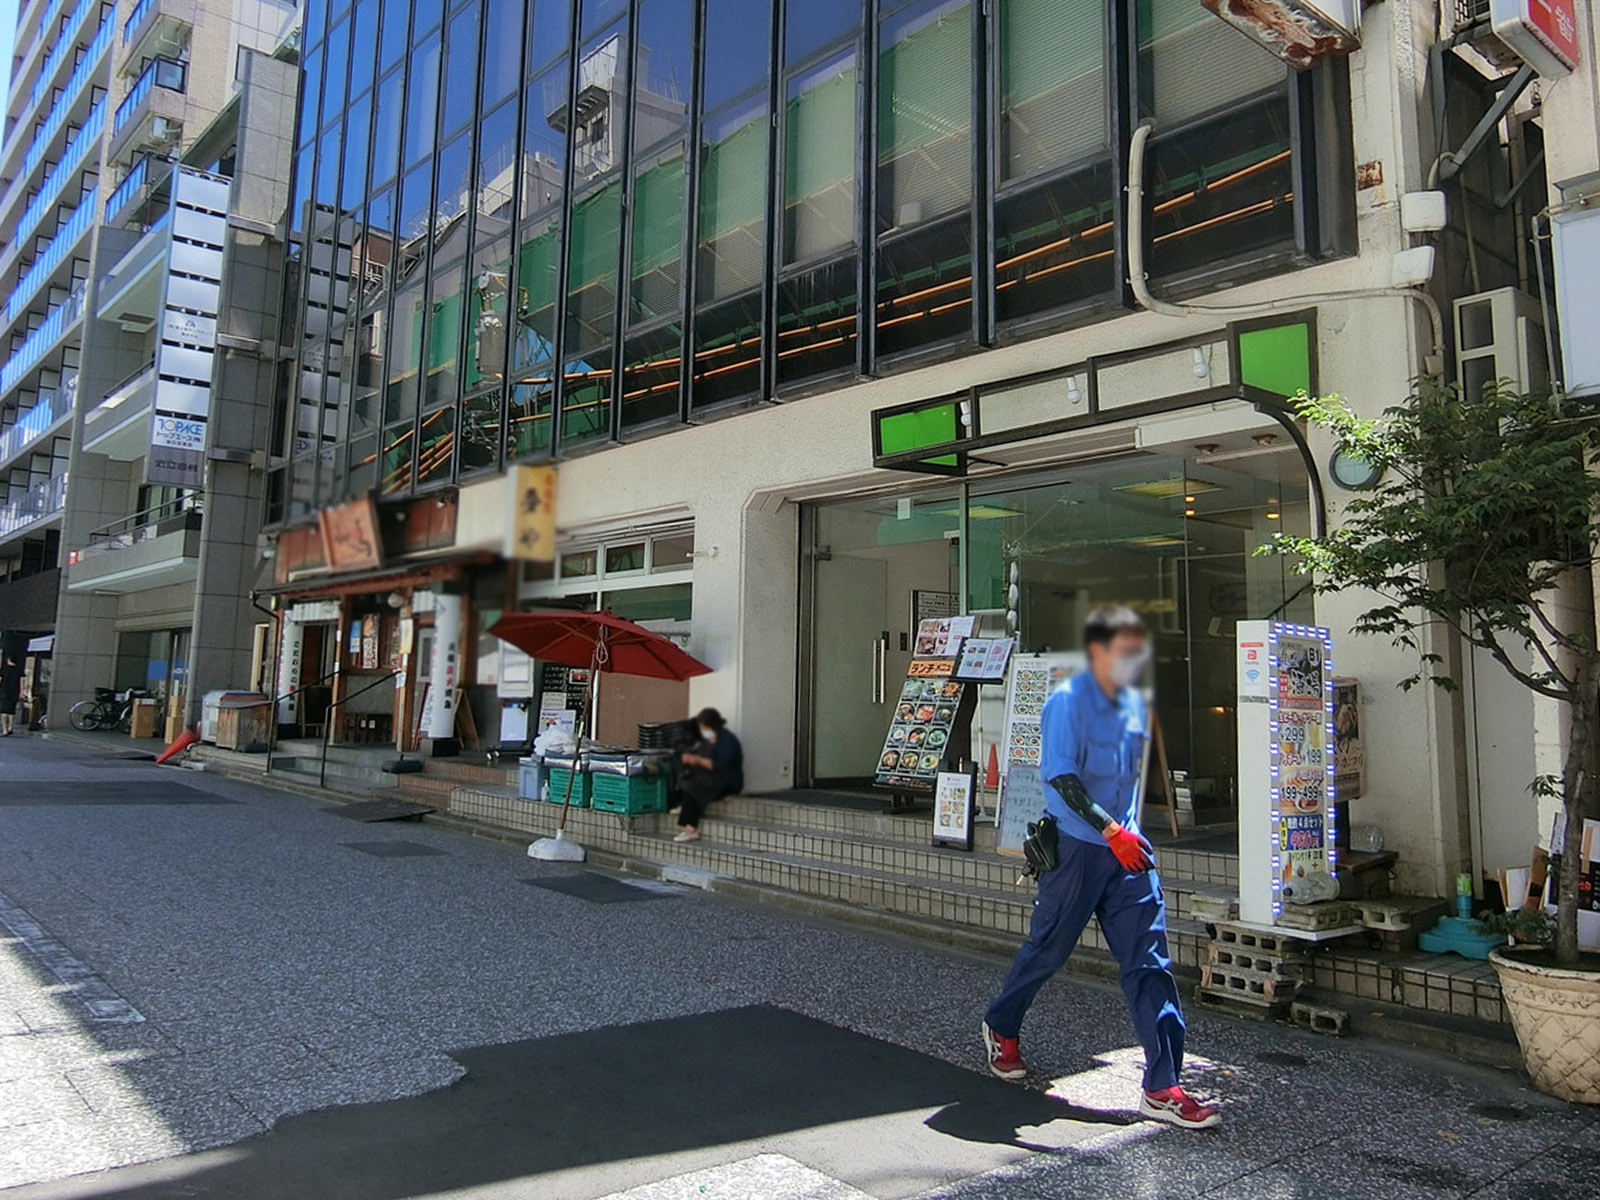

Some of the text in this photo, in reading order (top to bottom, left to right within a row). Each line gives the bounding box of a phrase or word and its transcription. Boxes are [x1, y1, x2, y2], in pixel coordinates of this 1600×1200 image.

[1308, 647, 1320, 662] B1
[911, 663, 952, 674] ランチメニュ
